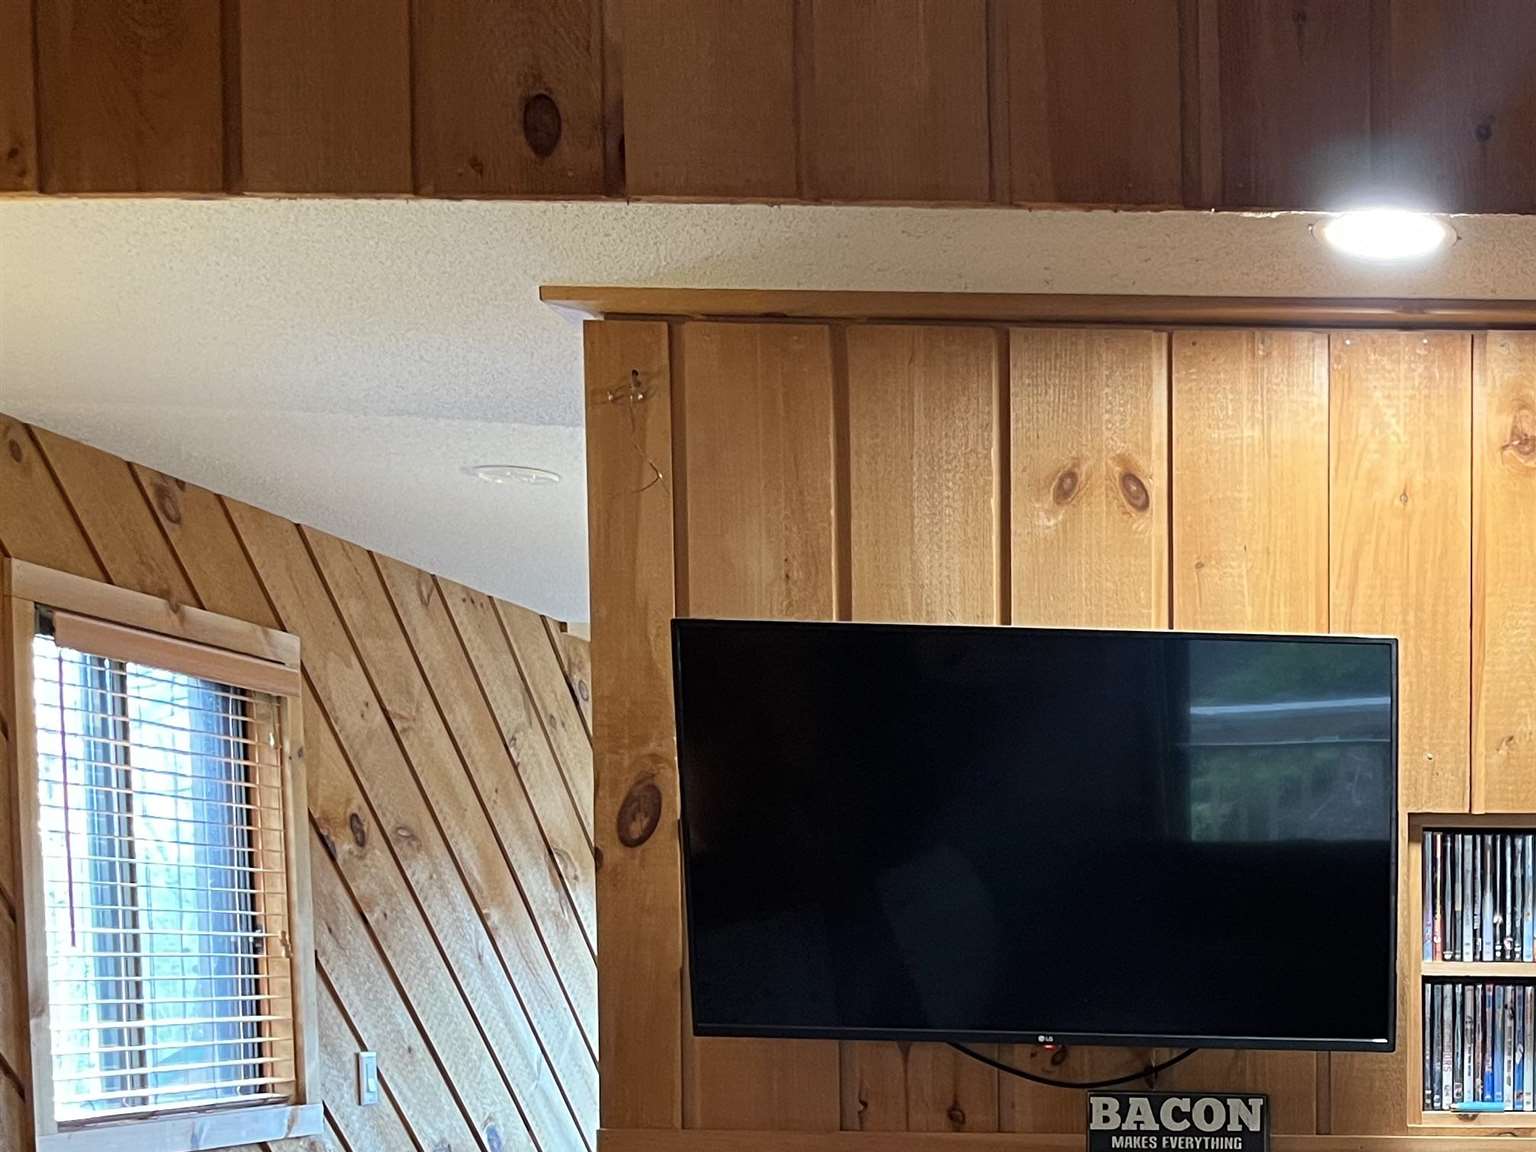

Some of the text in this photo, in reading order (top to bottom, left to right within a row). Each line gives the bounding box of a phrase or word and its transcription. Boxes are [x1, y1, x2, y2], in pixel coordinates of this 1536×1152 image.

[1089, 1096, 1264, 1132] BACON
[1111, 1135, 1243, 1150] MAKES EVERYTHING
